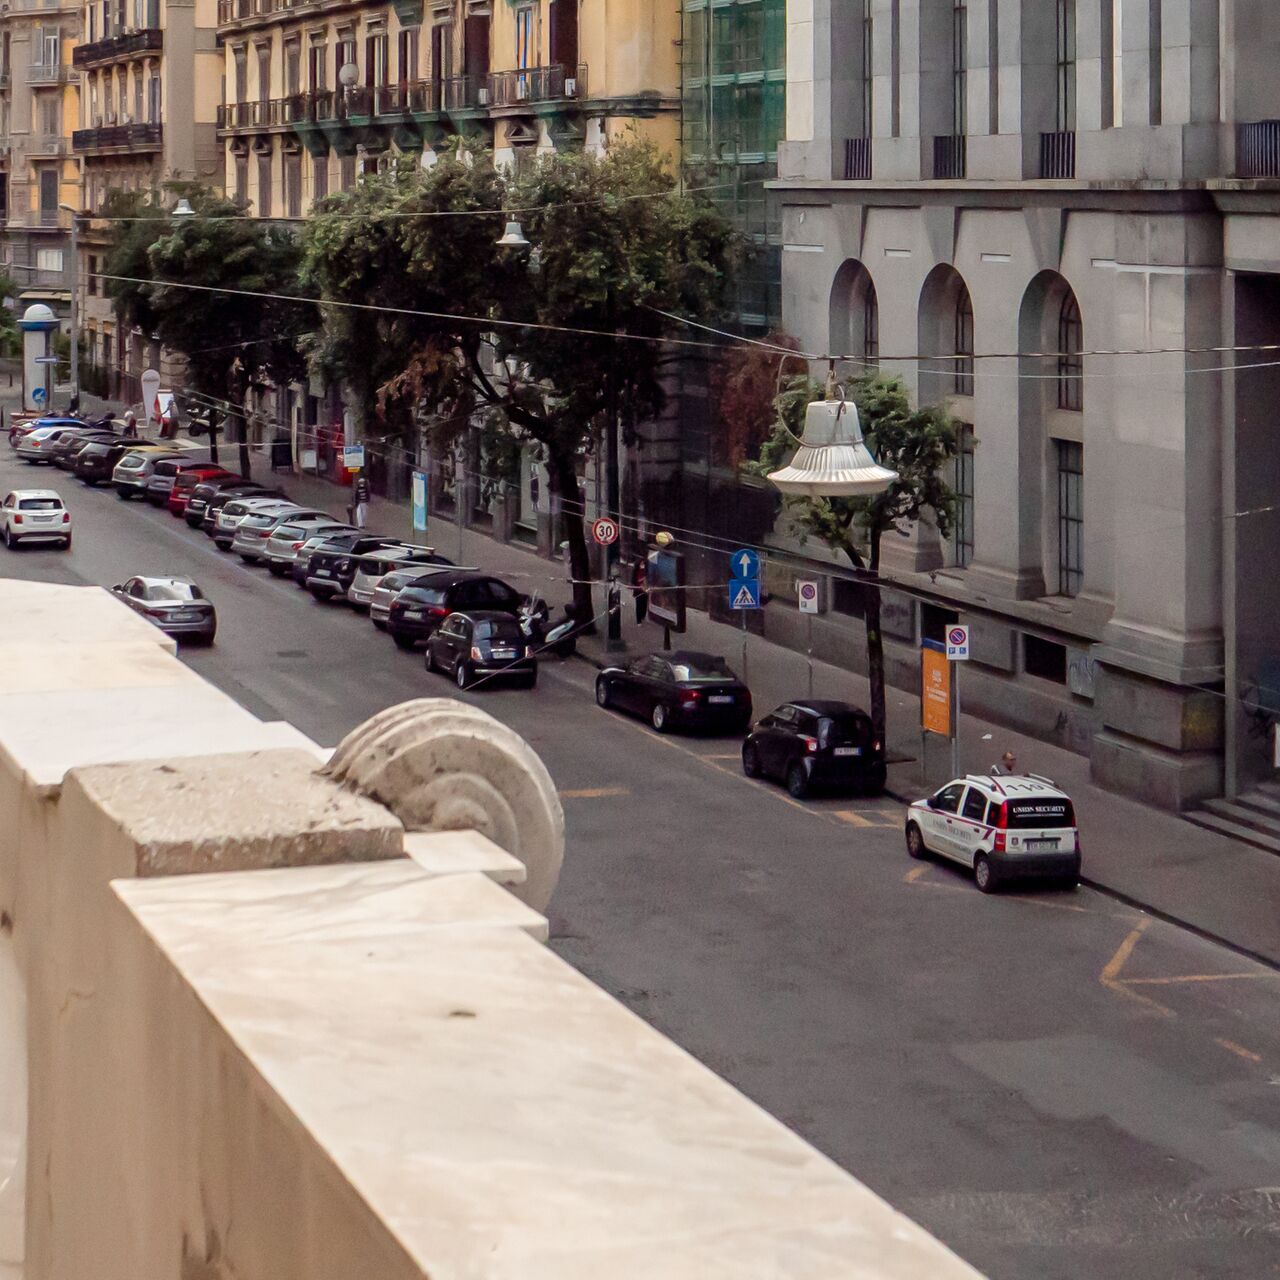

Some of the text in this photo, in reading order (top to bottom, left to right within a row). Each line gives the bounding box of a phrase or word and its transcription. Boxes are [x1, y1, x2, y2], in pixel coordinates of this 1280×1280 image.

[598, 525, 613, 537] 30
[1012, 805, 1066, 814] UNION SECURITY
